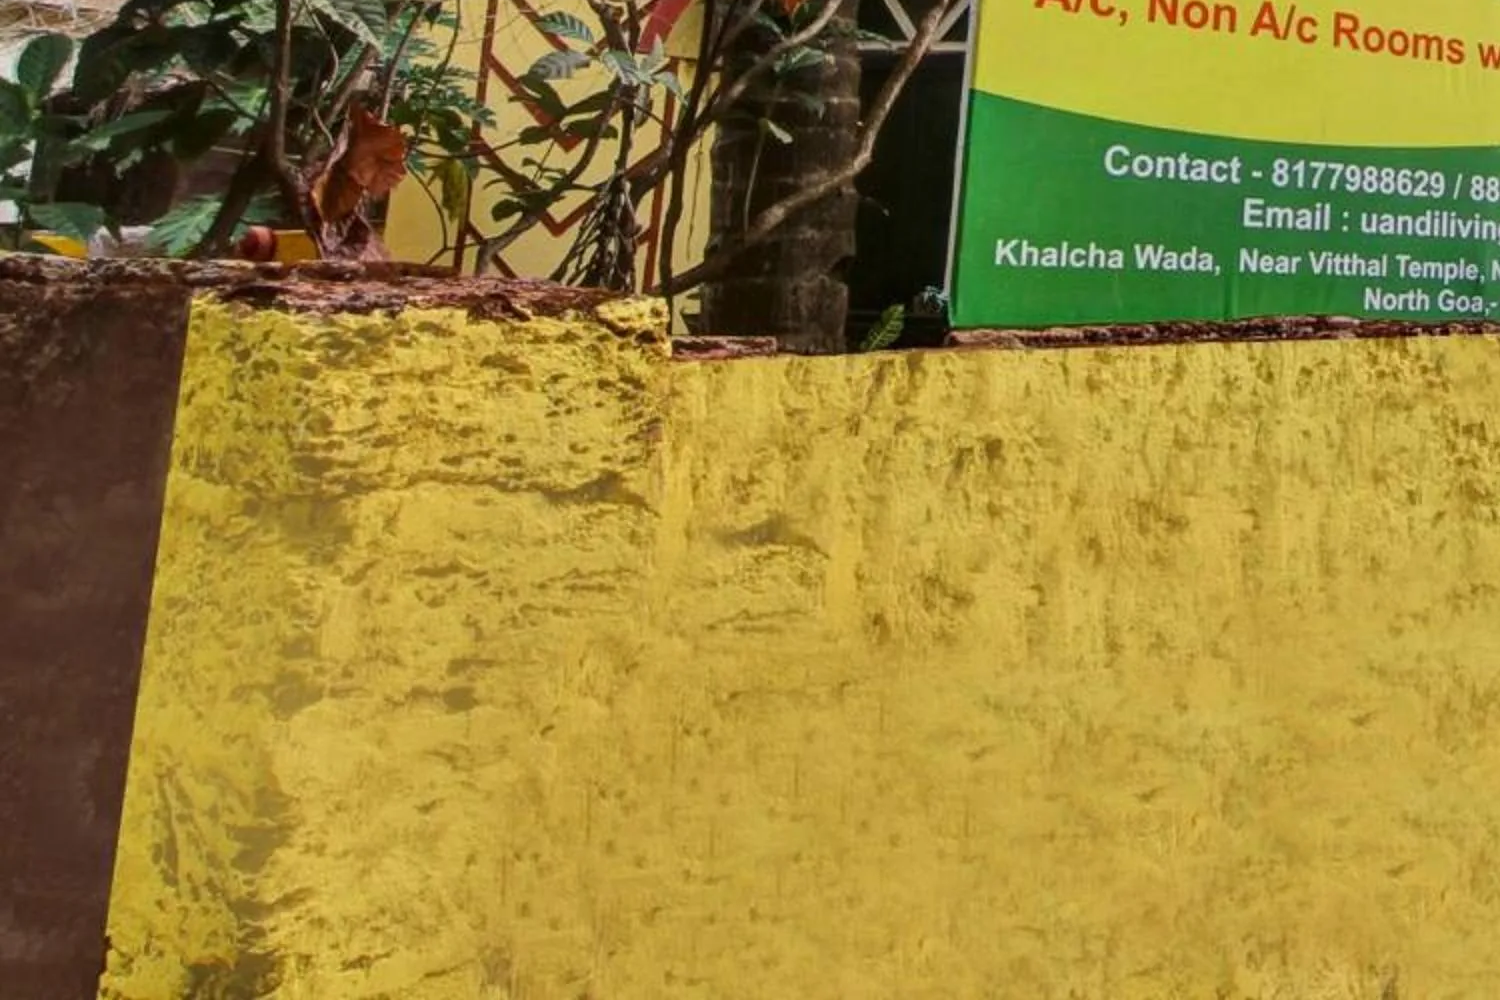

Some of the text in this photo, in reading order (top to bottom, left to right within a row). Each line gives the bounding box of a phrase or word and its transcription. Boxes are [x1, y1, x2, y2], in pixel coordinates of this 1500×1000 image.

[1249, 0, 1319, 44] A/c
[1332, 11, 1465, 65] Rooms
[1103, 144, 1242, 184] Contact
[1271, 157, 1446, 199] 8177988629
[1242, 197, 1332, 232] Email
[994, 238, 1125, 270] Khalcha
[1133, 242, 1222, 276] Wada,
[1238, 248, 1302, 275] Near
[1308, 250, 1388, 278] Vitthal
[1395, 254, 1486, 284] Temple,
[1363, 286, 1431, 312] North
